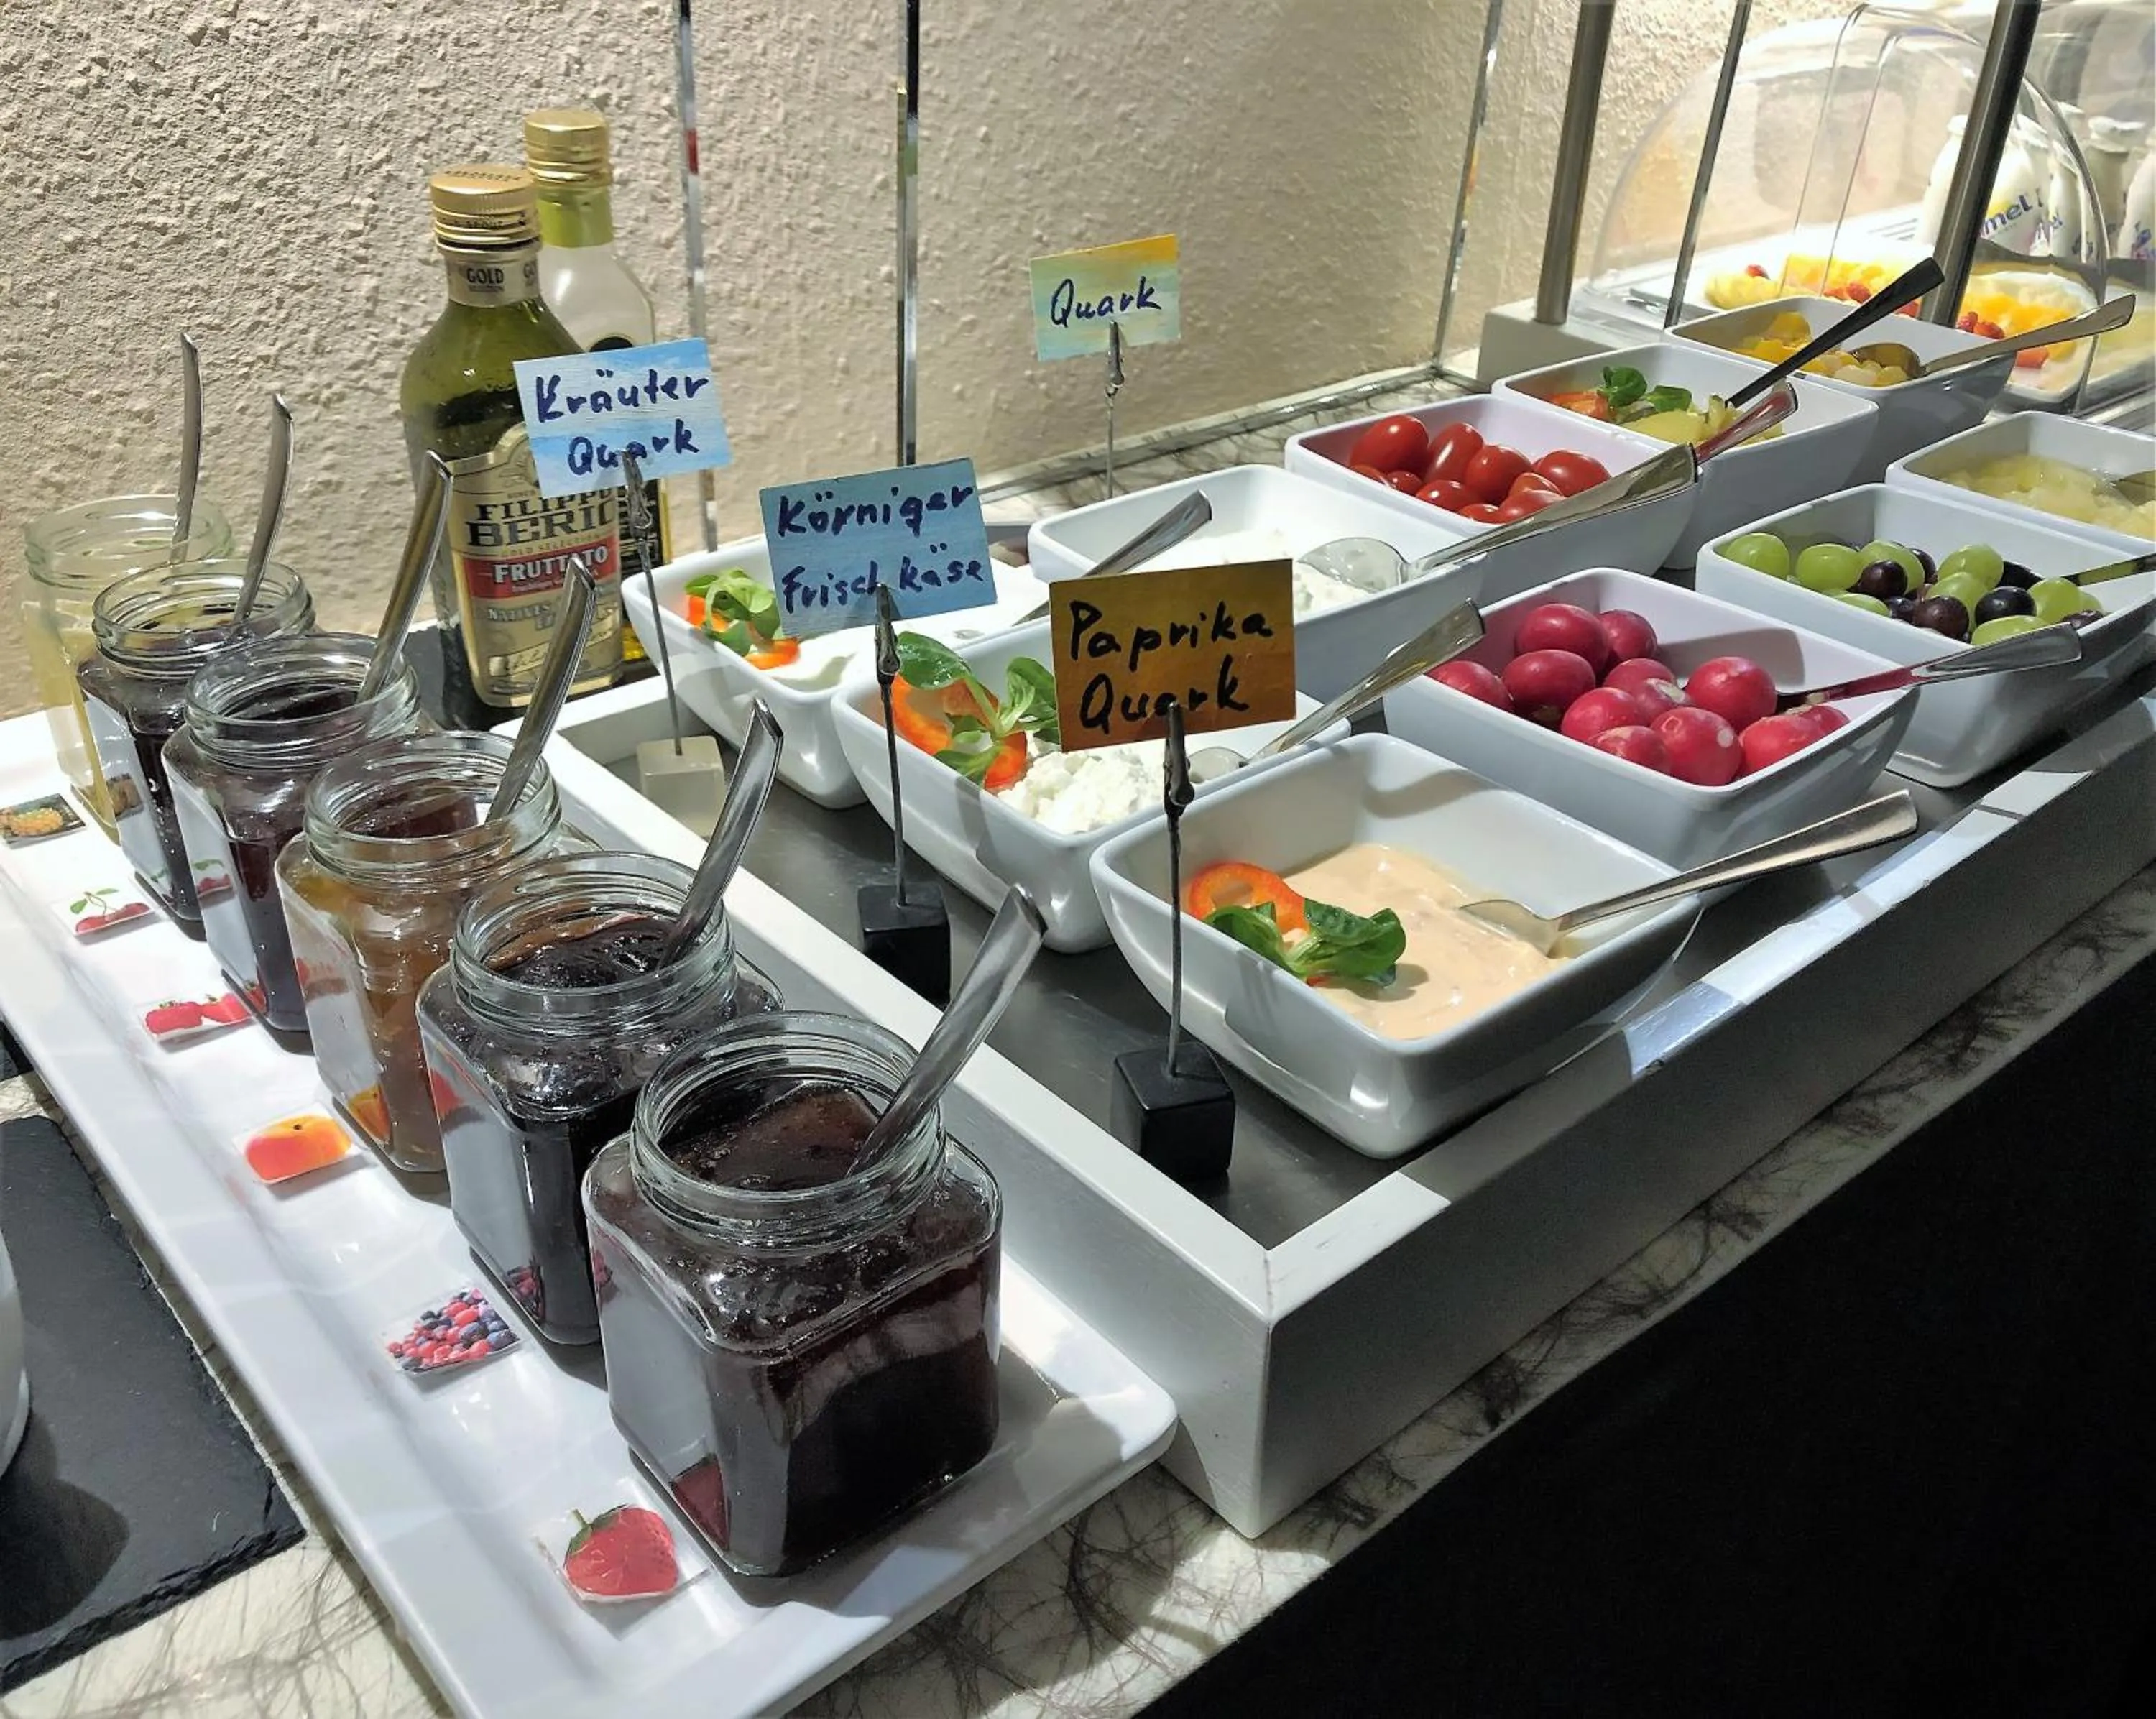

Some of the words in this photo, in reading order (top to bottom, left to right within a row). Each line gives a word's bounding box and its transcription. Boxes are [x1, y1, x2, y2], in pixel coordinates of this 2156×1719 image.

[466, 268, 505, 284] GOLD
[1051, 276, 1162, 328] Quark
[535, 369, 709, 423] Kräuter
[568, 418, 699, 476] Quark
[778, 486, 974, 538] Körniger
[494, 545, 609, 584] FRUTTTO
[1069, 600, 1273, 672] Paprika
[1079, 654, 1250, 734] Quark
